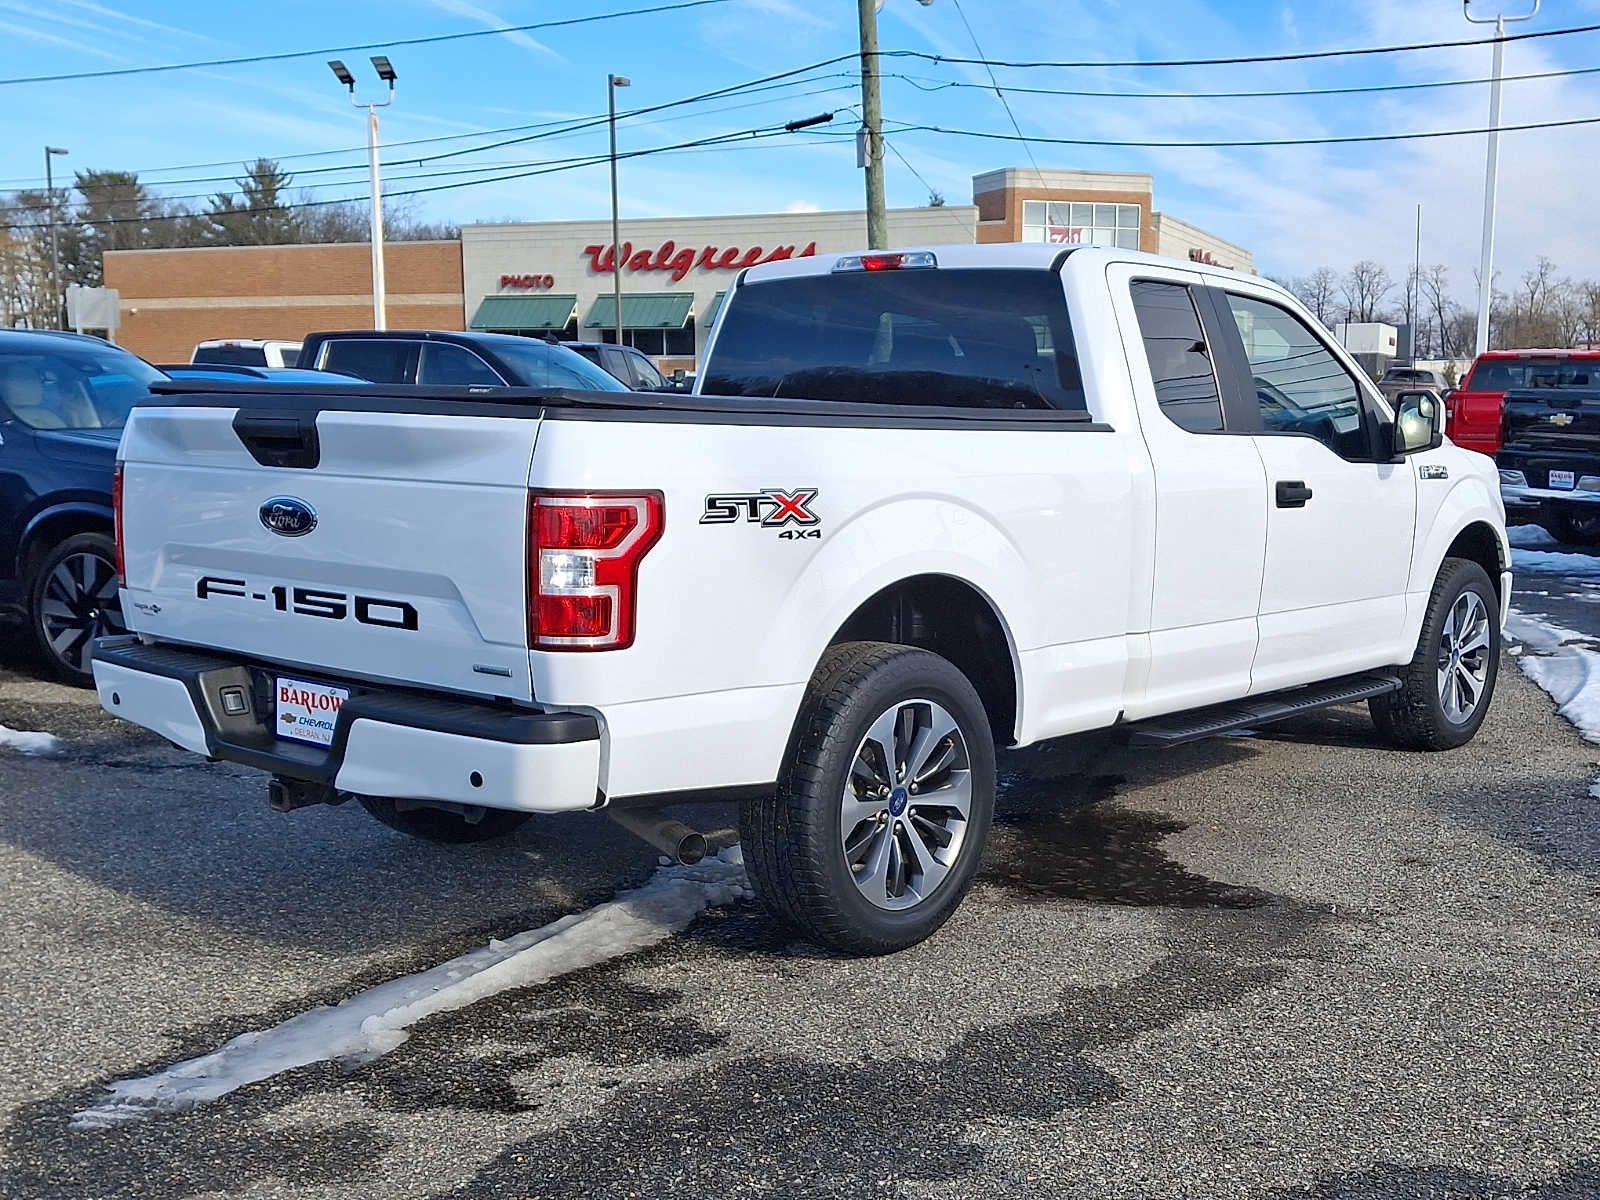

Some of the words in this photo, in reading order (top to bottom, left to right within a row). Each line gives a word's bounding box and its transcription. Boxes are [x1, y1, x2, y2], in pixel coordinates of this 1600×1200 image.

[584, 239, 817, 282] Walgreens
[499, 273, 555, 290] PHOTO
[699, 487, 822, 528] STX
[195, 575, 420, 632] F-150
[279, 686, 344, 716] BARLOW
[298, 716, 335, 731] CHEVROL
